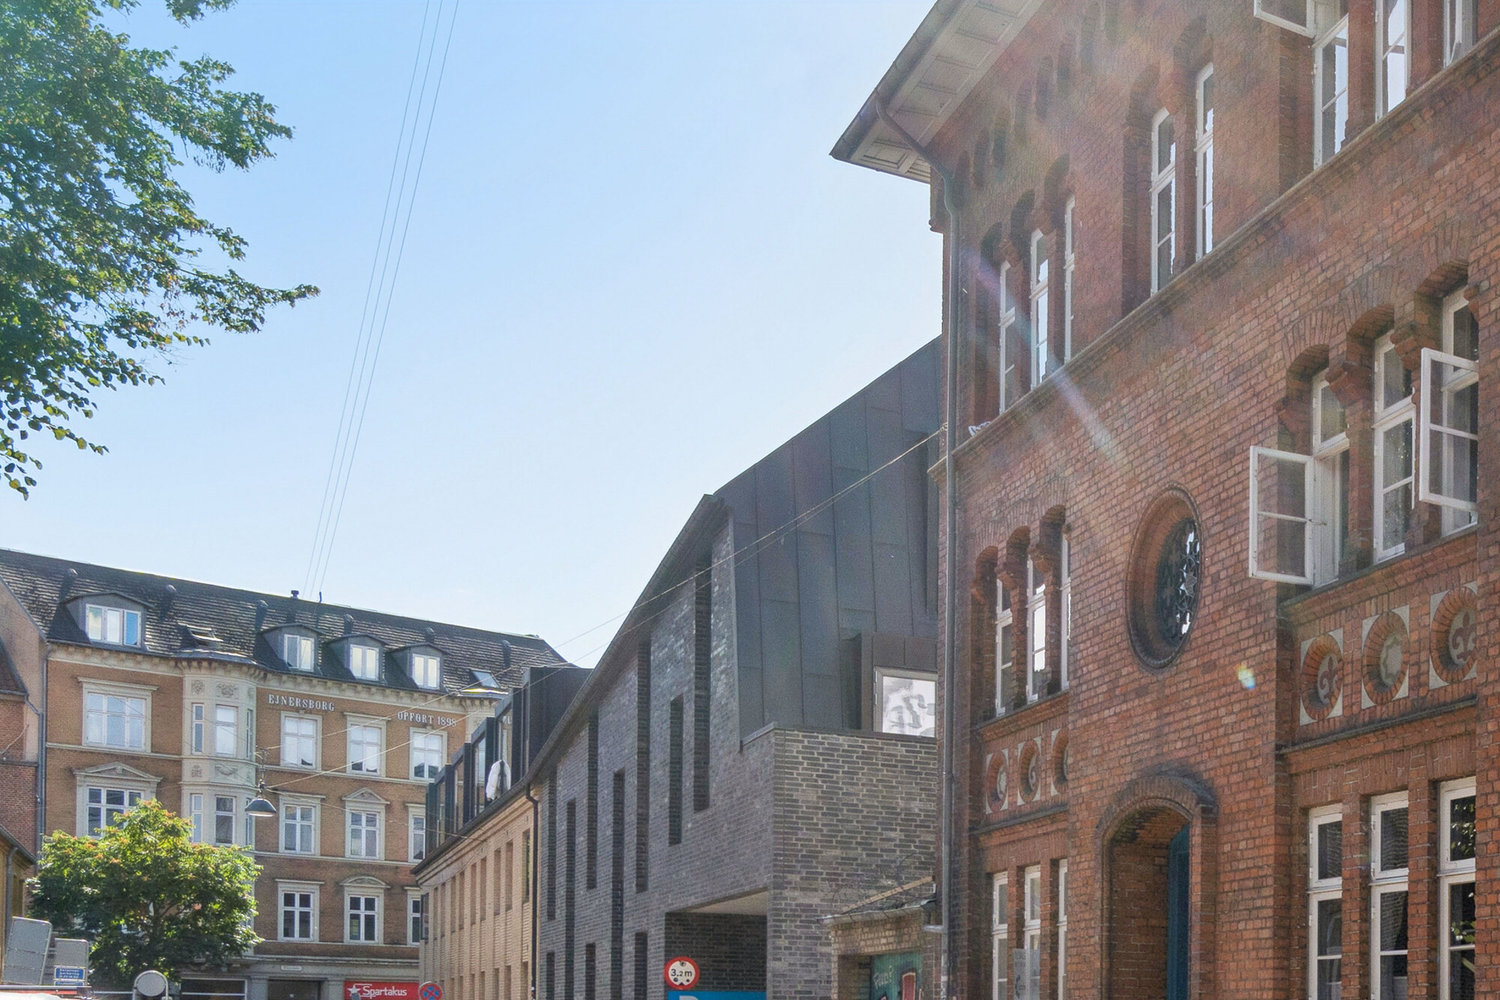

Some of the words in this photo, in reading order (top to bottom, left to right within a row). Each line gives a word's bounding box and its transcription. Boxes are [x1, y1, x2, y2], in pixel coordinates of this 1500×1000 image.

[268, 693, 335, 712] EJNERSBORG
[437, 716, 456, 727] 1898
[670, 968, 683, 977] 3.2
[362, 985, 408, 999] Spartakus
